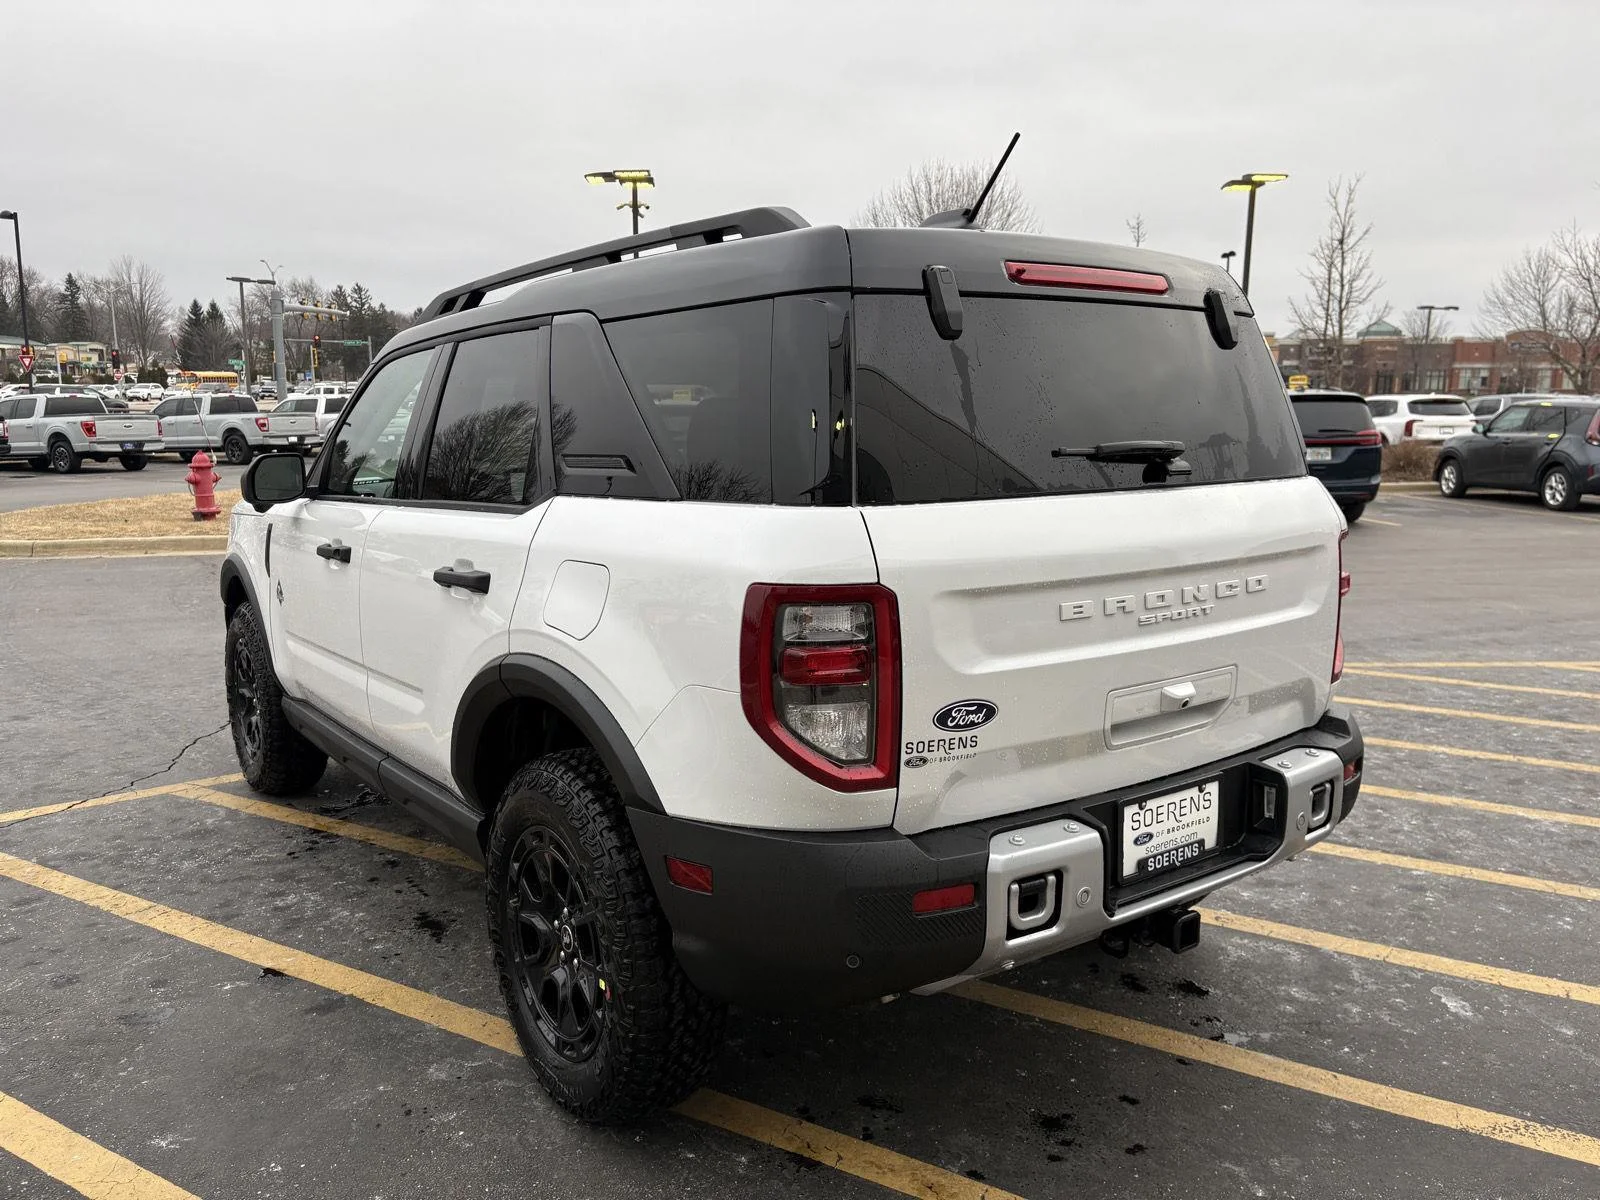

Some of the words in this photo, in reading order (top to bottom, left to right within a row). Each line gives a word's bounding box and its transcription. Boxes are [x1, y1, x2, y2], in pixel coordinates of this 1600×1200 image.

[1059, 574, 1269, 621] BRONCO
[1138, 604, 1215, 627] SPORT
[946, 705, 987, 728] Ford
[904, 735, 978, 756] SOERENS
[939, 752, 978, 763] BROOKFIELD
[1131, 791, 1212, 831] SOERENS
[1166, 816, 1211, 835] BROOKFIELD
[1145, 831, 1198, 855] soerens.com
[1147, 843, 1199, 872] SOERENS
